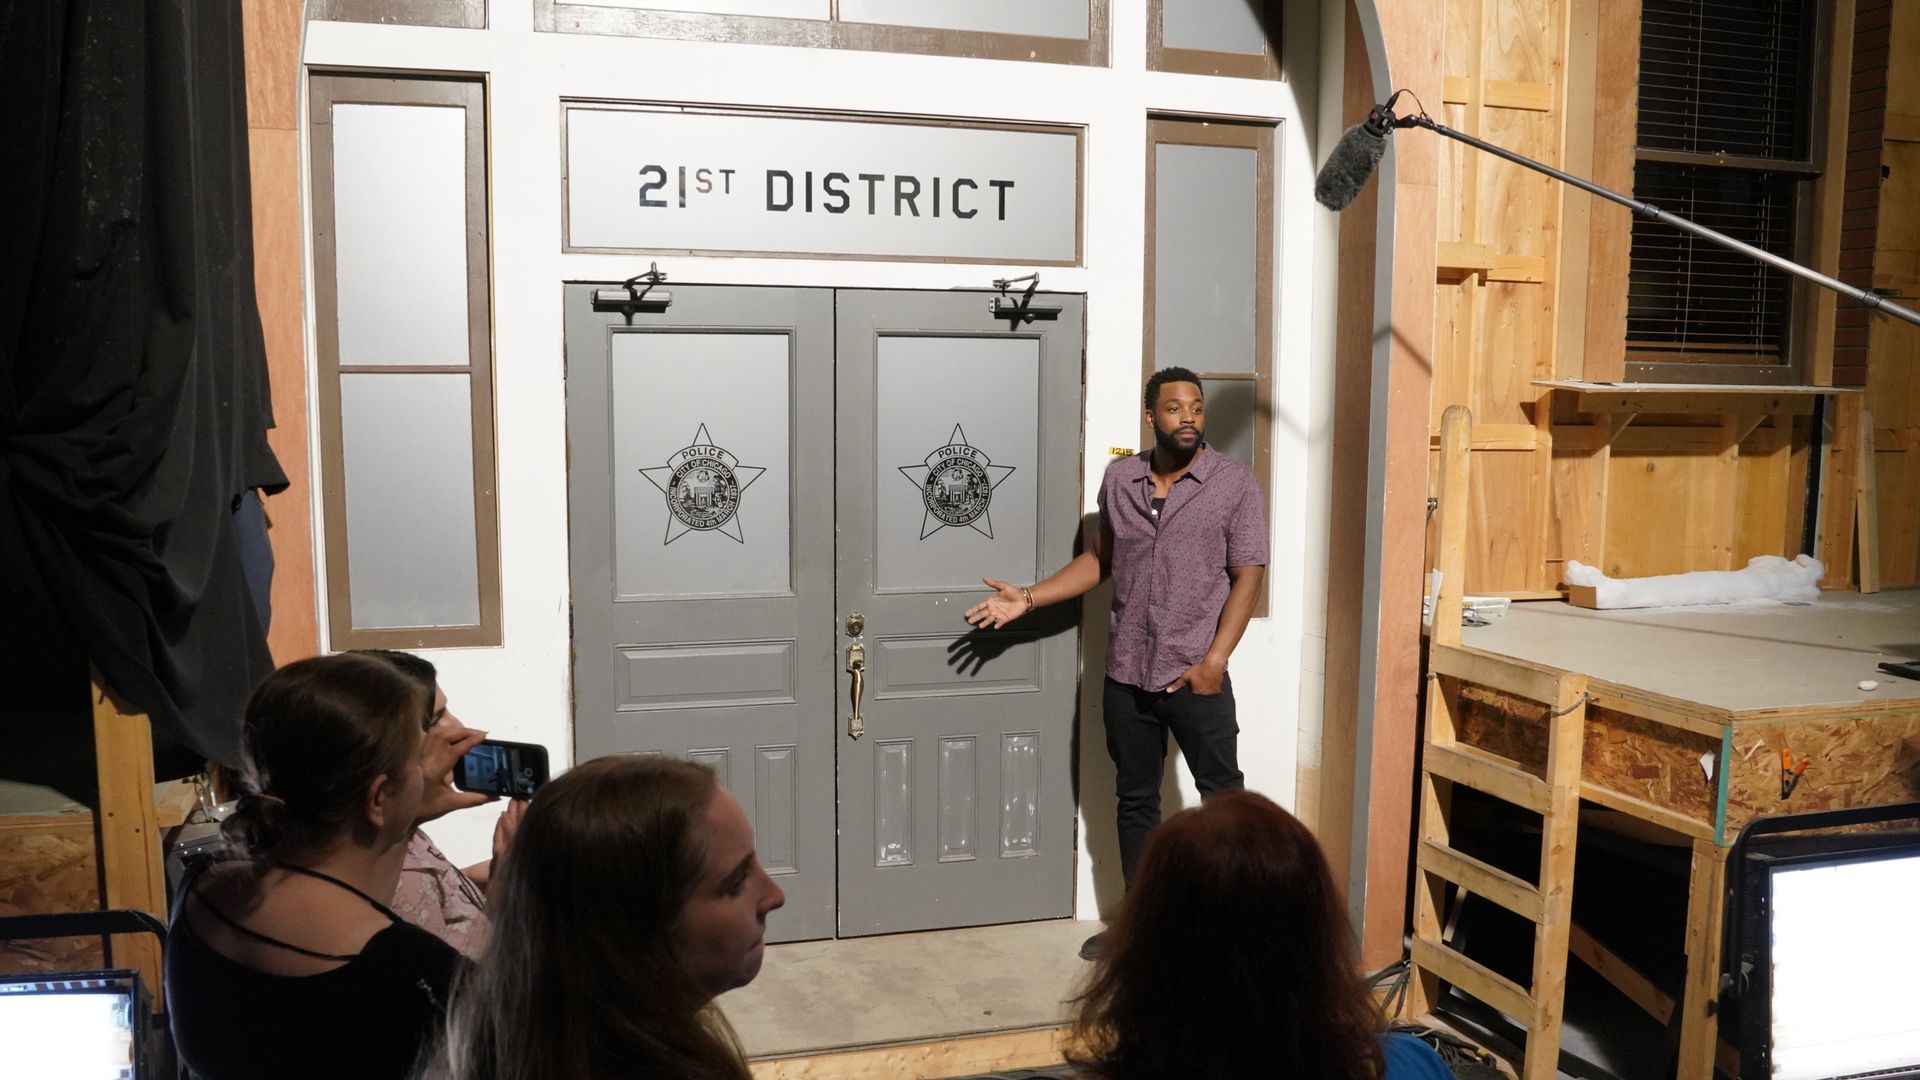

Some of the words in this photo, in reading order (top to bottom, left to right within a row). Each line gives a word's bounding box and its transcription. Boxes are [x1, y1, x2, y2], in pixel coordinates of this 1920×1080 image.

[639, 164, 736, 209] 21ST
[766, 168, 1016, 222] DISTRICT
[682, 447, 725, 459] POLICE
[938, 447, 978, 458] POLICE
[1111, 447, 1133, 457] 1215
[676, 462, 690, 478] CITY
[702, 460, 731, 478] CHICAGO
[932, 462, 946, 477] CITY
[946, 459, 956, 467] OF
[956, 459, 983, 477] CHICAGO
[669, 486, 705, 527] INCORPORATED
[715, 500, 736, 524] MARCH
[925, 484, 958, 523] INCORPORATED
[968, 498, 987, 520] MARCH
